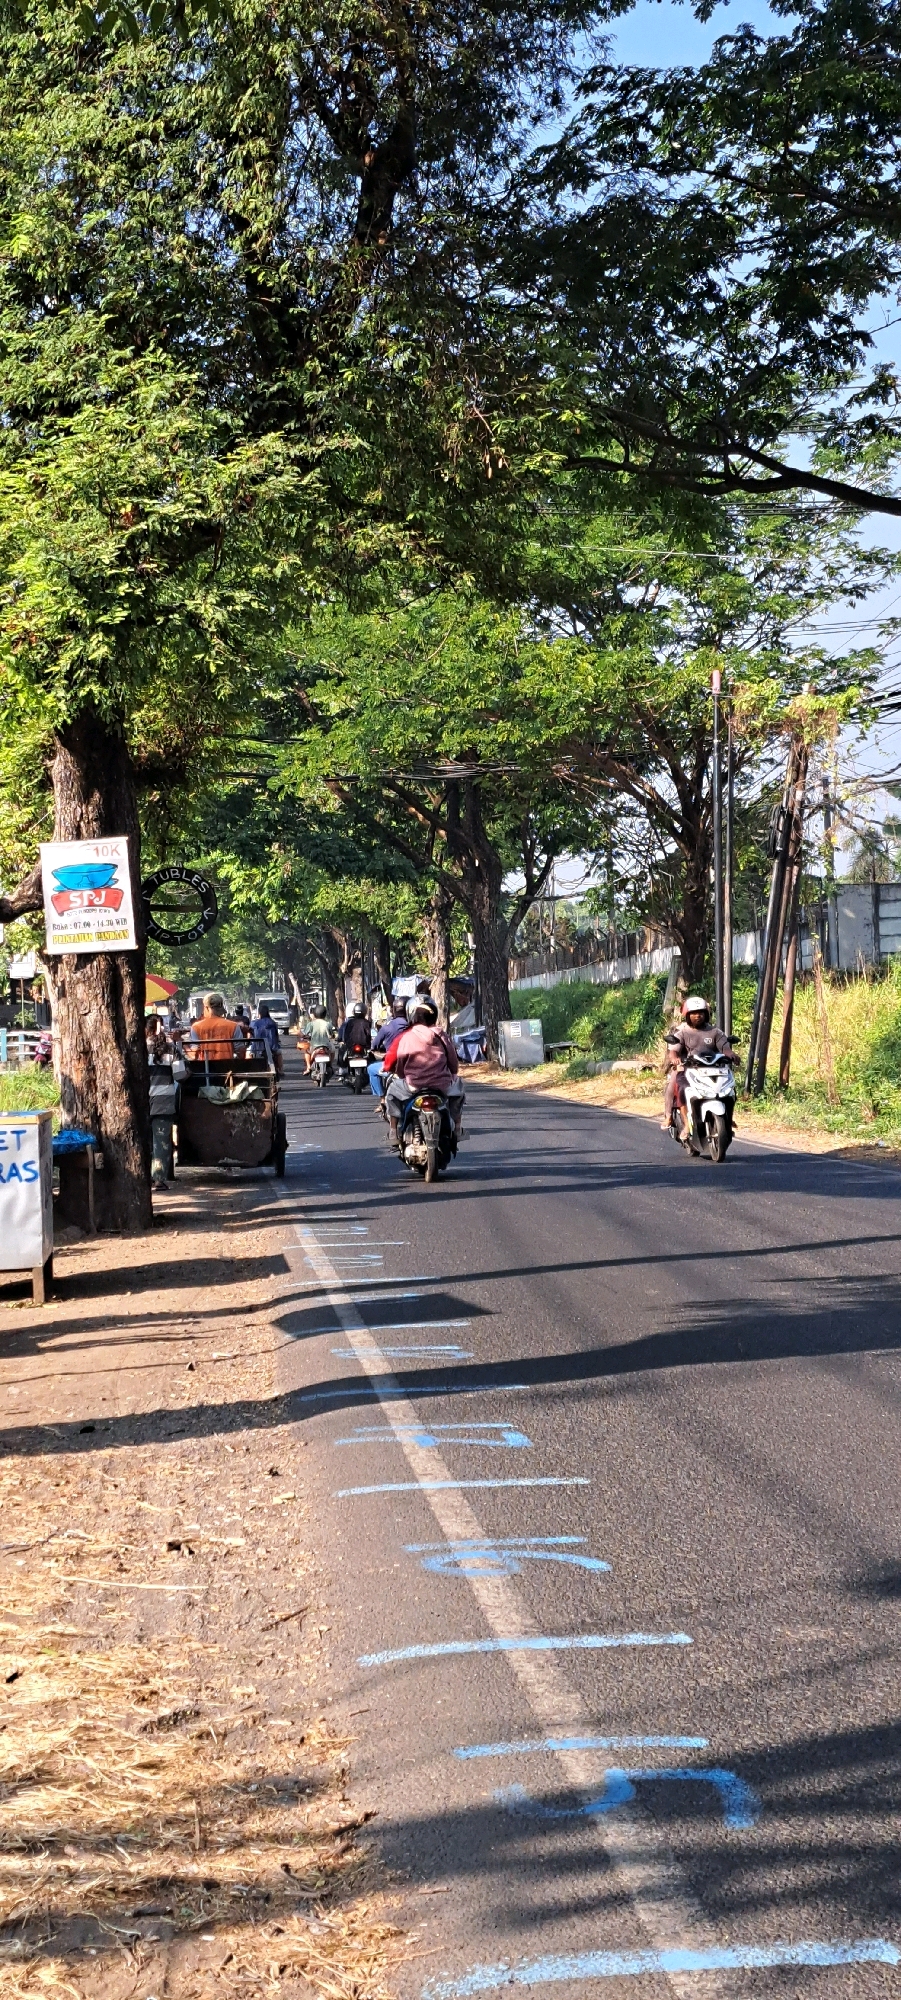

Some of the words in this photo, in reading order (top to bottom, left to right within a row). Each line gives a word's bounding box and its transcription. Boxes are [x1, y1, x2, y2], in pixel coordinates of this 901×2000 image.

[93, 844, 121, 857] 10K
[148, 868, 210, 893] TUBLES
[69, 890, 106, 908] SPJ
